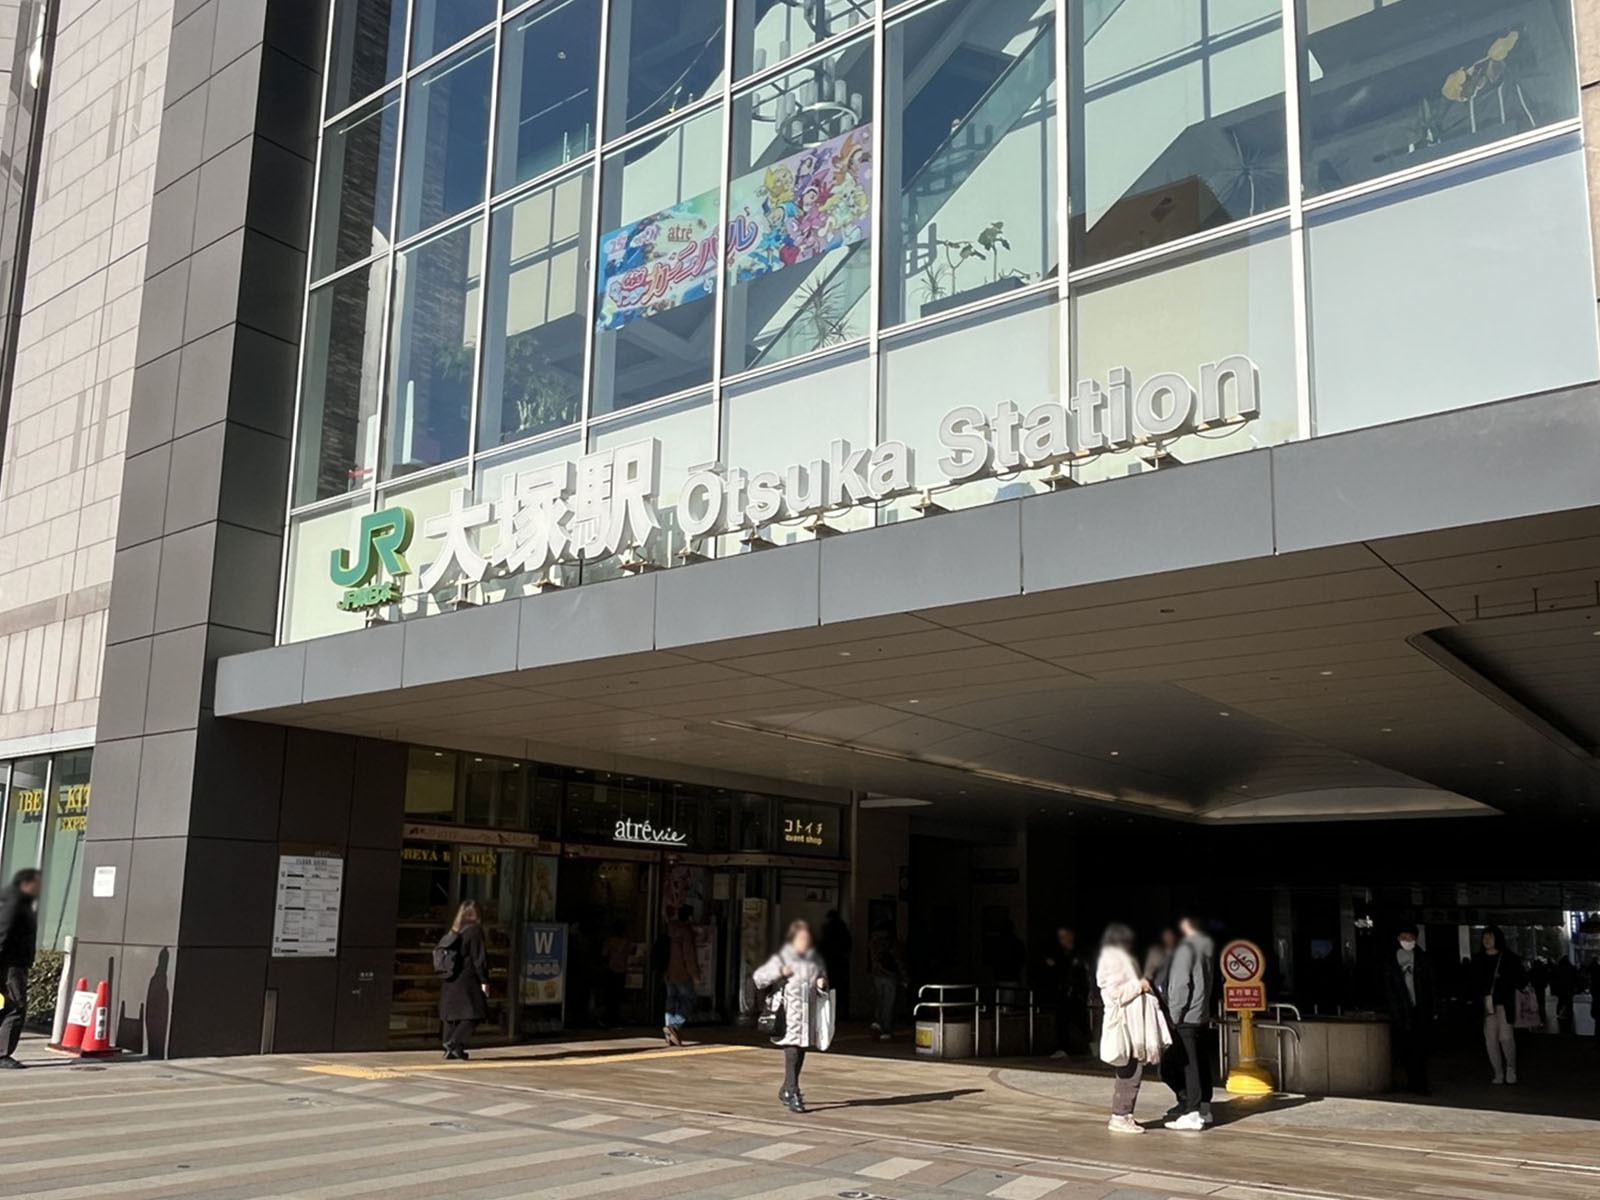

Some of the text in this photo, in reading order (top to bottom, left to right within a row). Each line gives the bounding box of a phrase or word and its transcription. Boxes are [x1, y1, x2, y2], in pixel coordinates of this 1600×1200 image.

[668, 223, 693, 242] atré
[676, 353, 1261, 538] Ōtsuka Station
[417, 436, 662, 594] 大塚駅
[330, 506, 414, 588] JR
[784, 818, 824, 835] コトイチ
[534, 931, 554, 954] W
